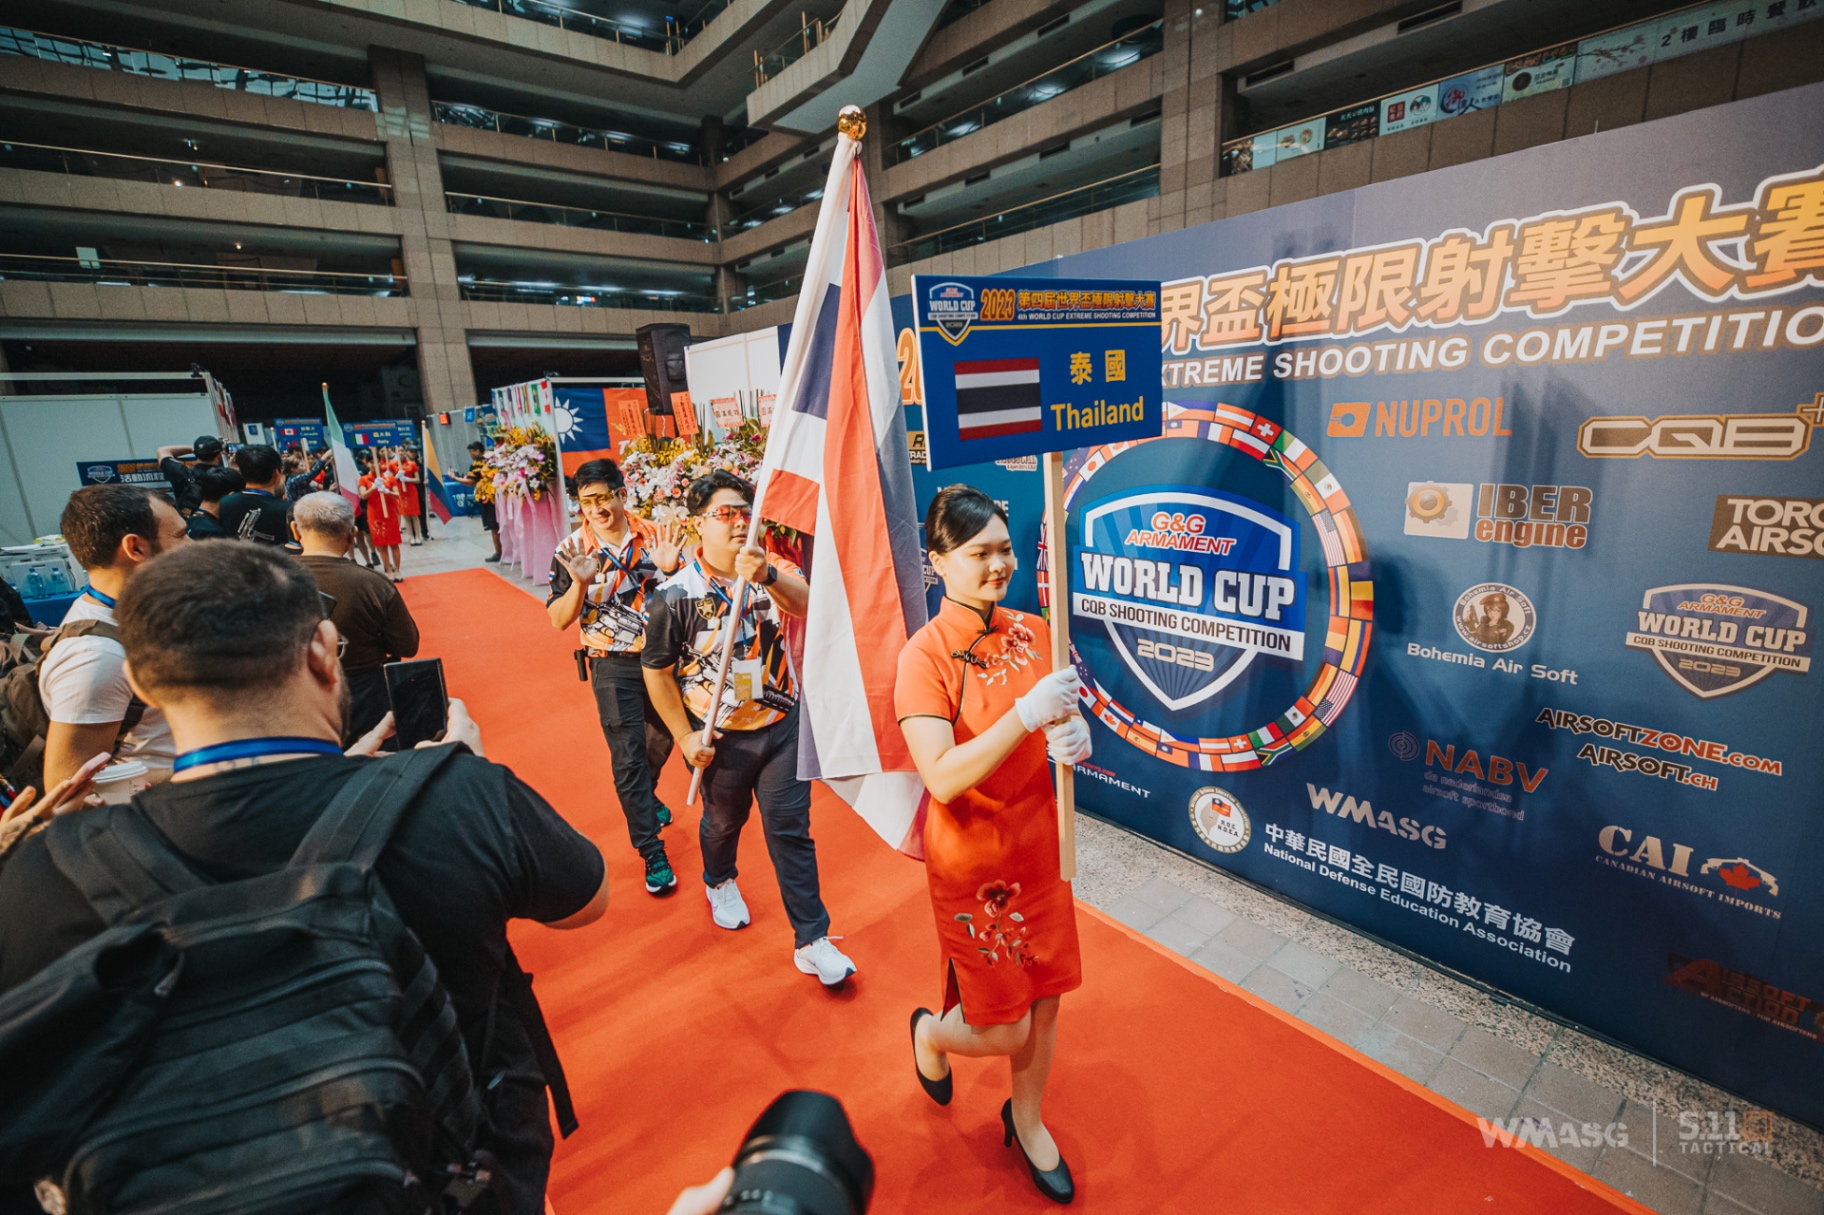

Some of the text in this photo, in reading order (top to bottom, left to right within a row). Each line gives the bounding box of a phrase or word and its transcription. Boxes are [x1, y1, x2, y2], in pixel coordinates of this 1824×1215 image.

[929, 300, 976, 311] WORLD CUP
[980, 288, 1016, 321] 2023
[1273, 334, 1470, 380] SHOOTING
[1050, 396, 1144, 431] Thailand
[1376, 397, 1512, 438] NUPROL
[1151, 511, 1206, 535] G&G
[1477, 483, 1593, 525] IBER
[1124, 528, 1236, 555] ARMAMENT
[1475, 518, 1587, 549] engine
[1716, 525, 1824, 556] AIRS
[1081, 552, 1295, 622] WORLD CUP
[1460, 586, 1532, 615] Bohemia Air Soft
[1700, 593, 1743, 608] G&G
[1081, 598, 1291, 652] CQB SHOOTING COMPETITION
[1677, 600, 1766, 619] ARMAMENT
[1633, 635, 1800, 668] CQB SHOOTING COMPETITION
[1638, 611, 1807, 653] WORLD CUP
[1137, 638, 1214, 672] 2023
[1407, 642, 1579, 686] Bohemia Air Soft
[1678, 658, 1742, 678] 2023
[1535, 707, 1783, 776] AIRSOFTZONE.COM
[1425, 739, 1549, 793] NABV
[1577, 743, 1718, 791] AIRSOFT.CH
[1422, 784, 1525, 821] airsoft sportbond
[1424, 770, 1512, 803] de nederlandse
[1306, 783, 1447, 850] WMASG
[1598, 824, 1695, 878] CAI
[1264, 822, 1576, 956] 中華民國全民國防教育協會
[1595, 854, 1782, 920] CANADIAN AIRSOFT IMPORTS
[1263, 842, 1572, 973] National Defense Education Association
